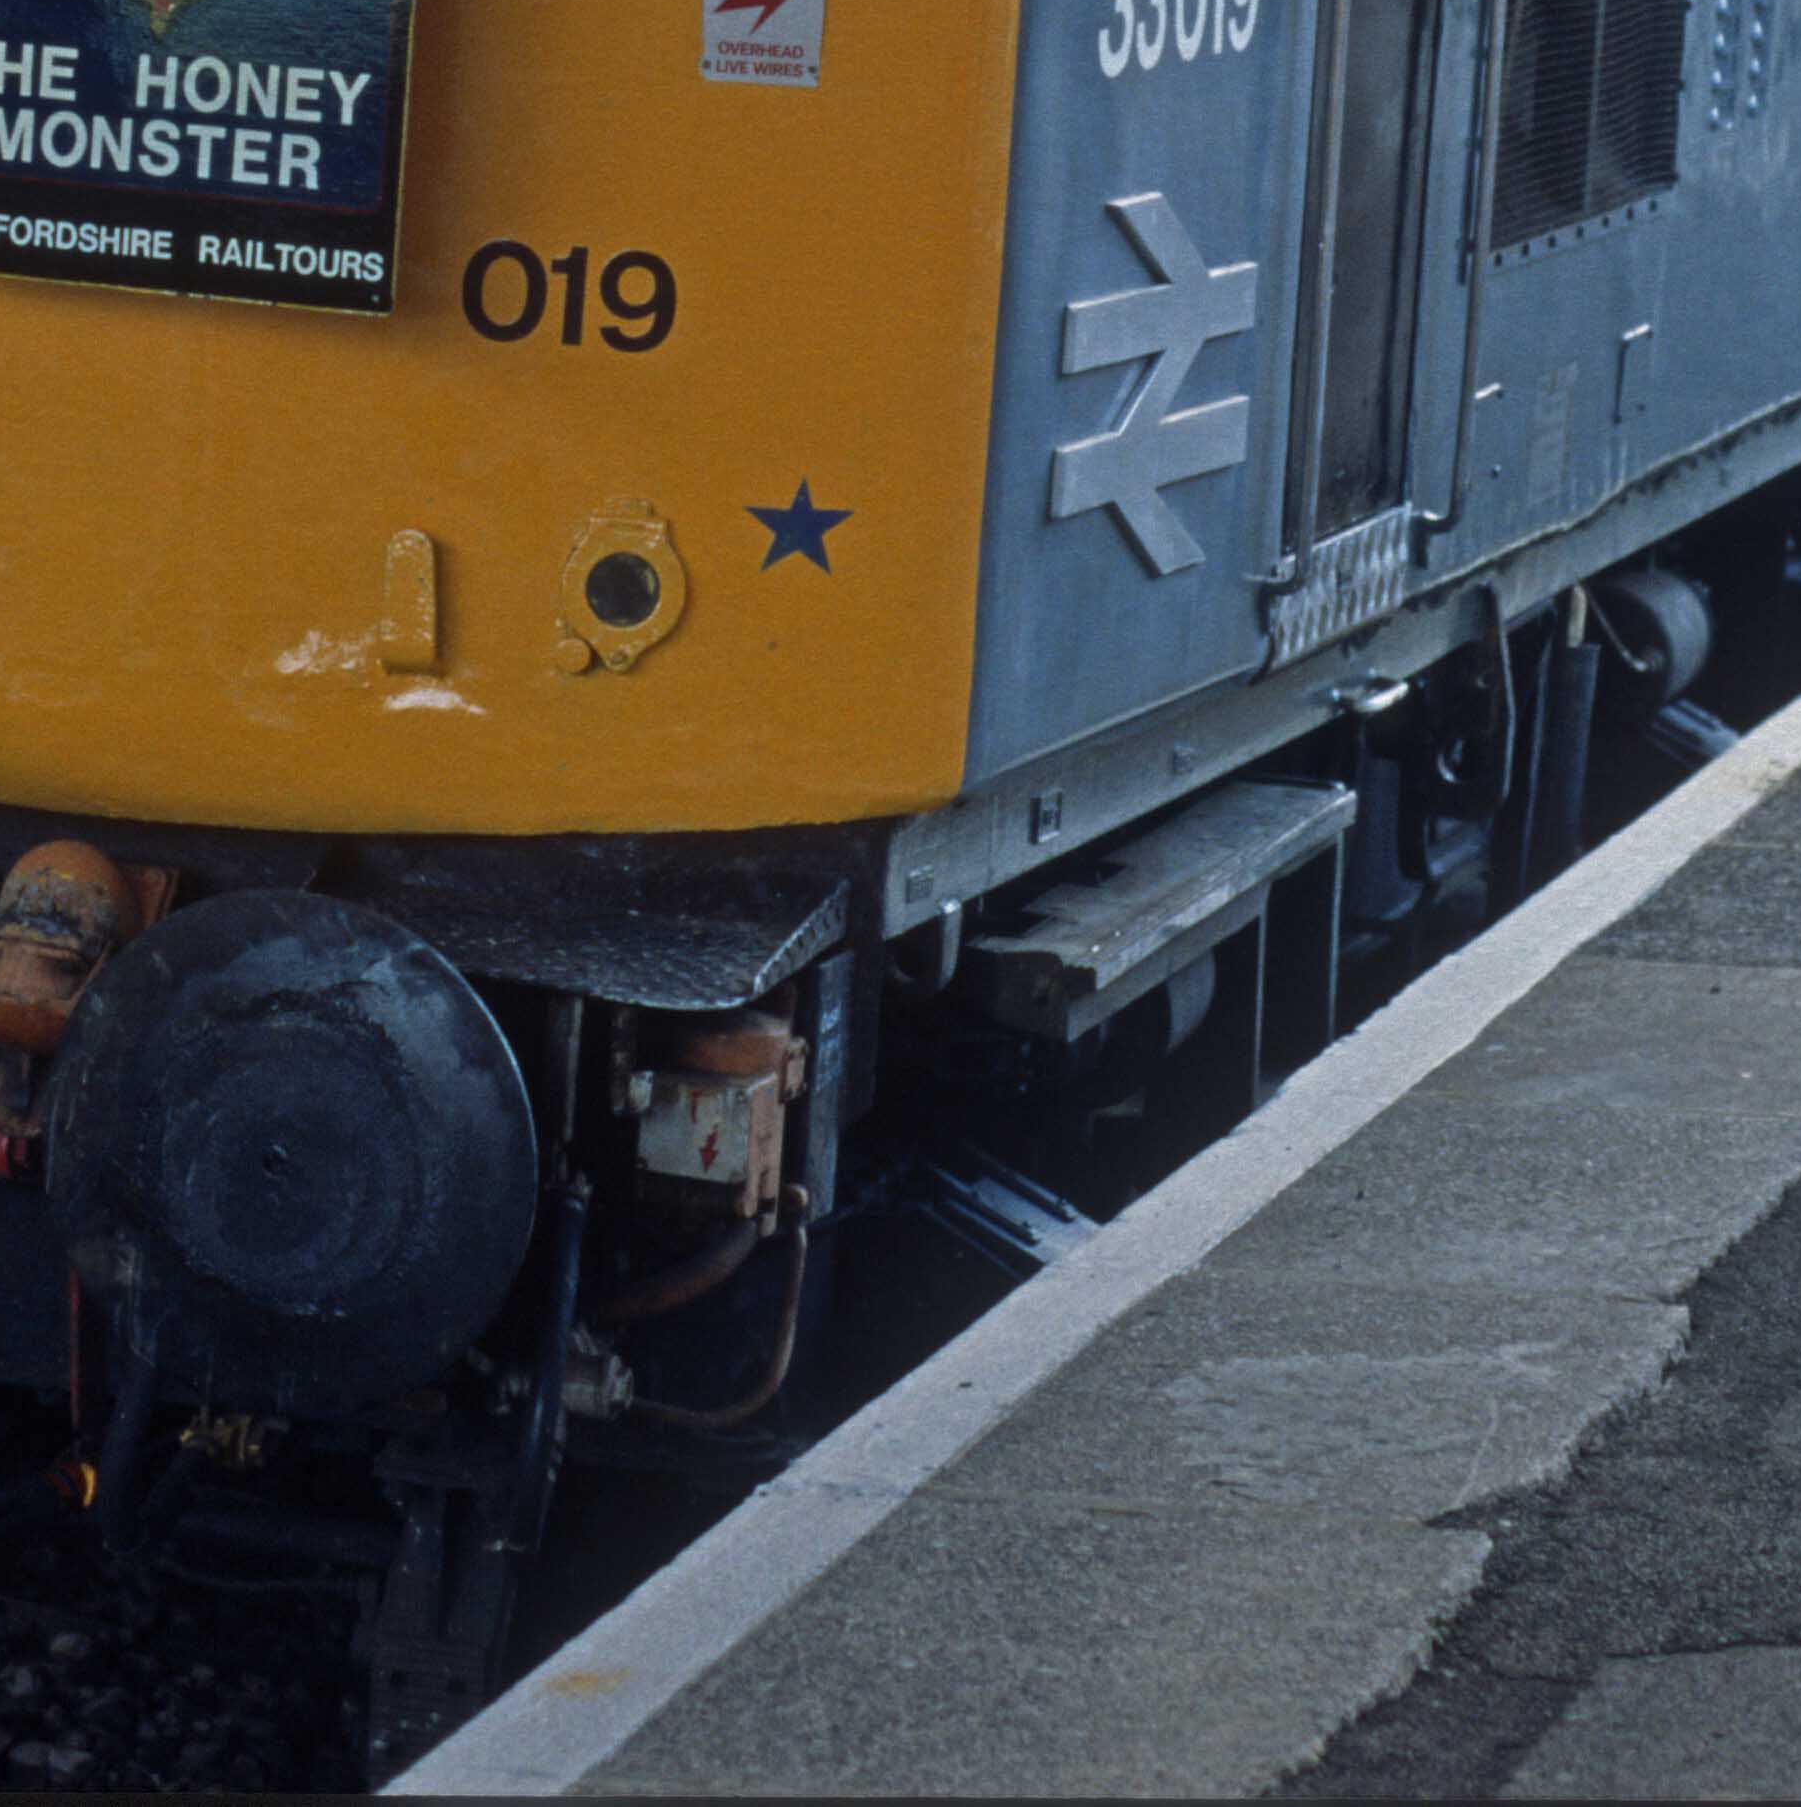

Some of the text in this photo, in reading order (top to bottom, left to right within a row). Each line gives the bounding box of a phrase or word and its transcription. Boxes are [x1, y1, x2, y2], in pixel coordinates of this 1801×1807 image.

[714, 59, 805, 79] LIVE WIRES
[716, 40, 806, 61] OVERHEAD
[134, 52, 372, 126] HONEY
[198, 235, 384, 282] RAILTOURS
[460, 239, 678, 354] 019
